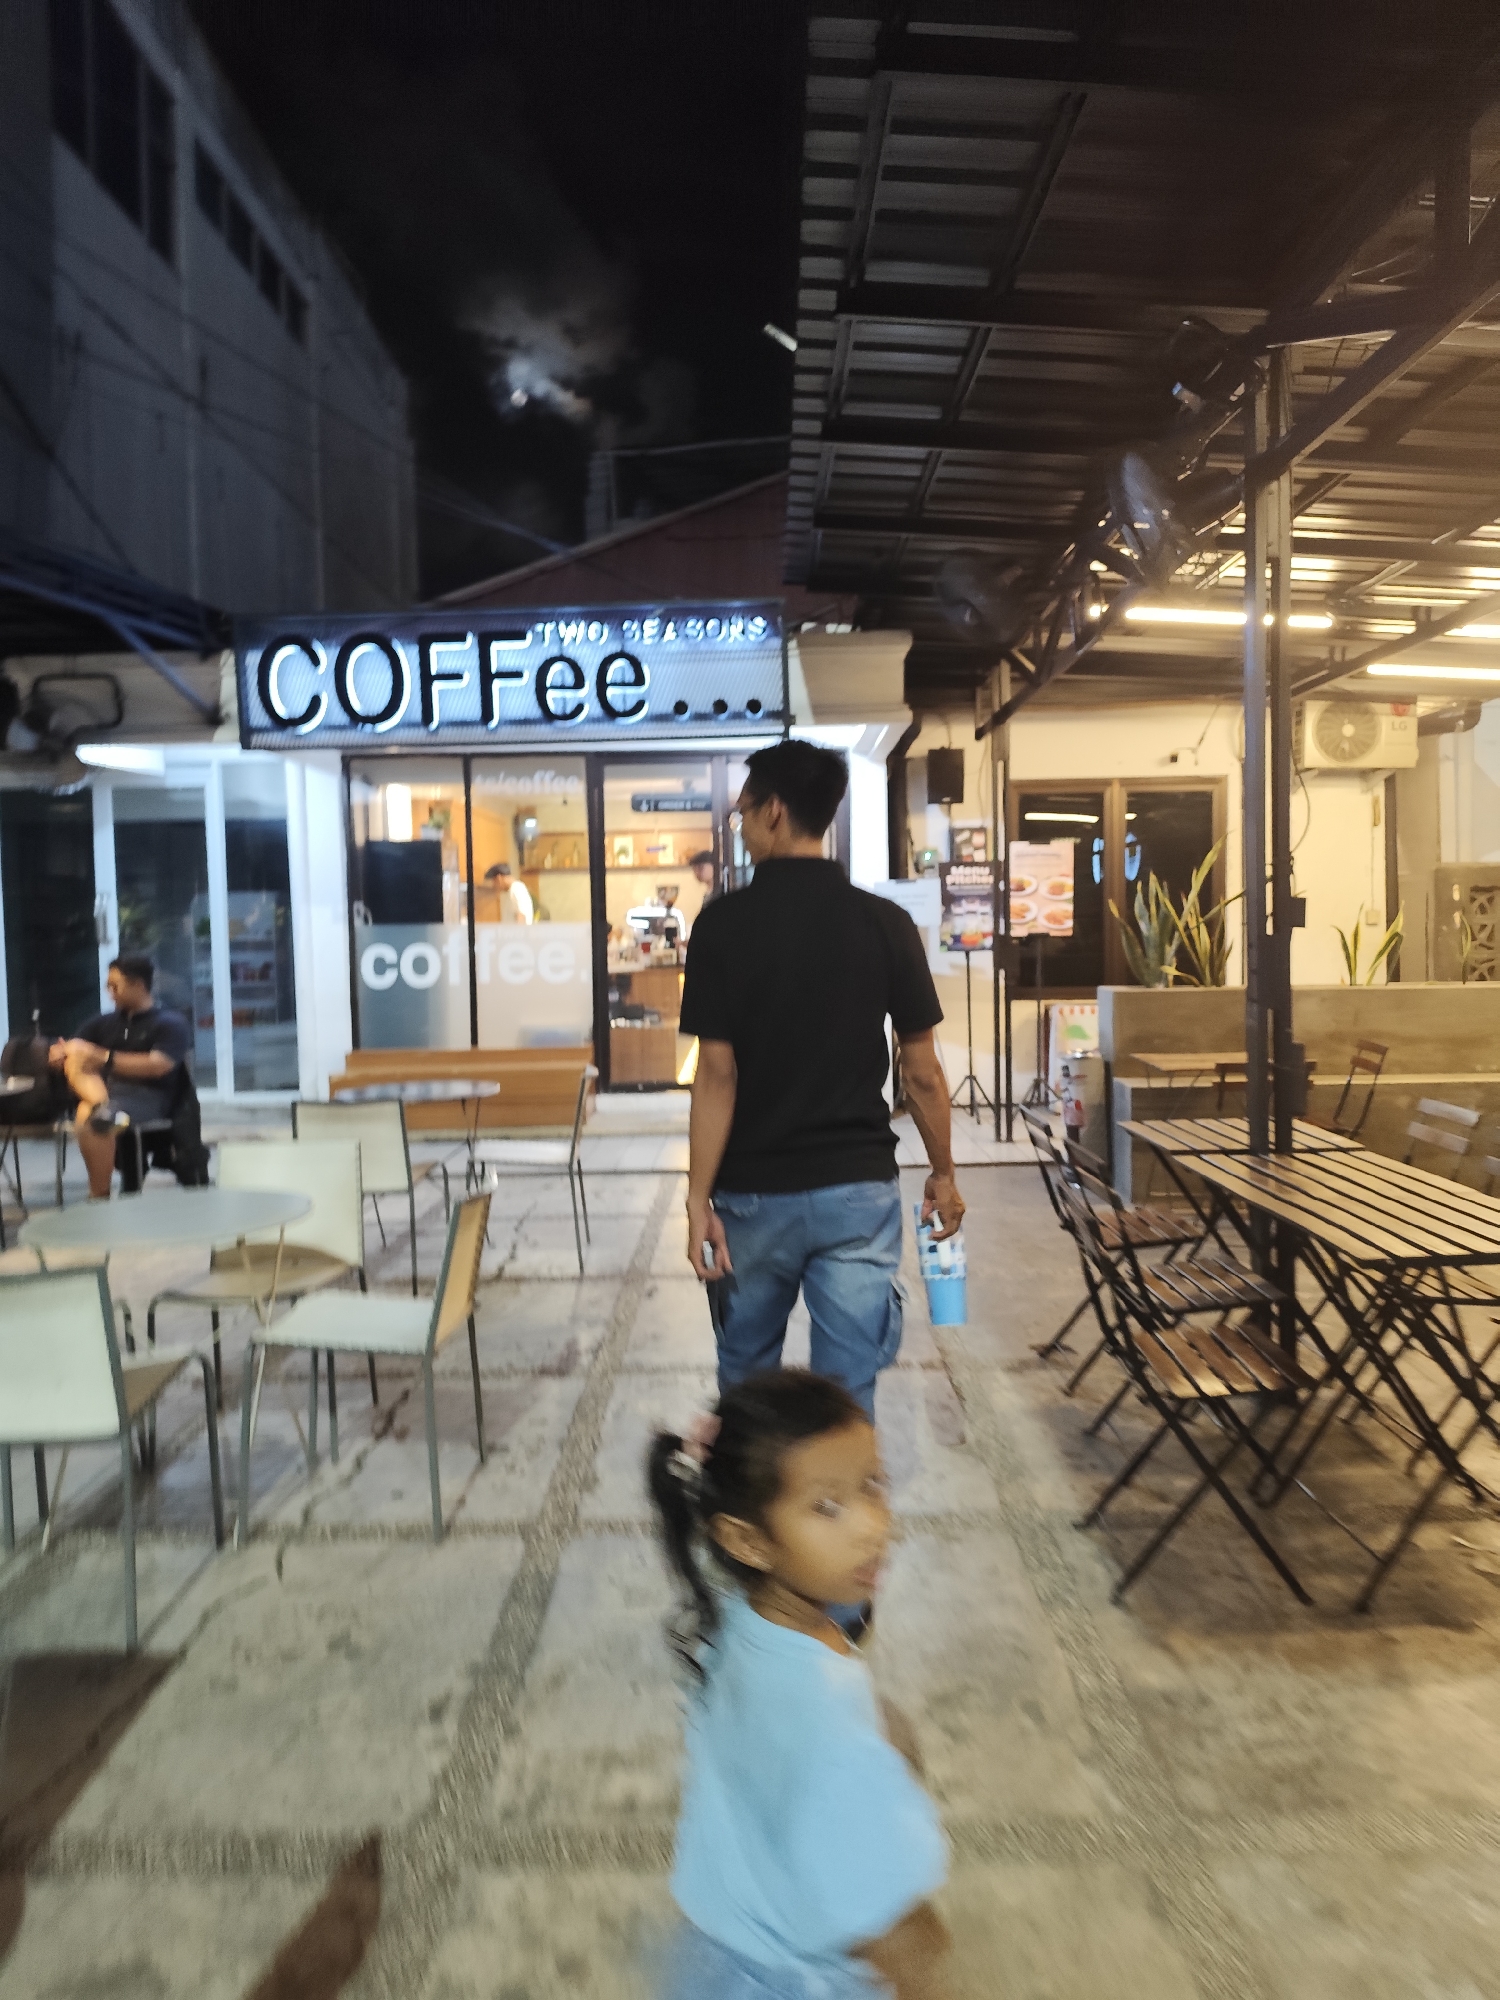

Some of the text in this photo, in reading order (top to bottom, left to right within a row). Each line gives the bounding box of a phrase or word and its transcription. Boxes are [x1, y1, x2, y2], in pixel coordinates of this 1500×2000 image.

[535, 615, 768, 648] TWO SEASONS
[1391, 720, 1408, 731] LG
